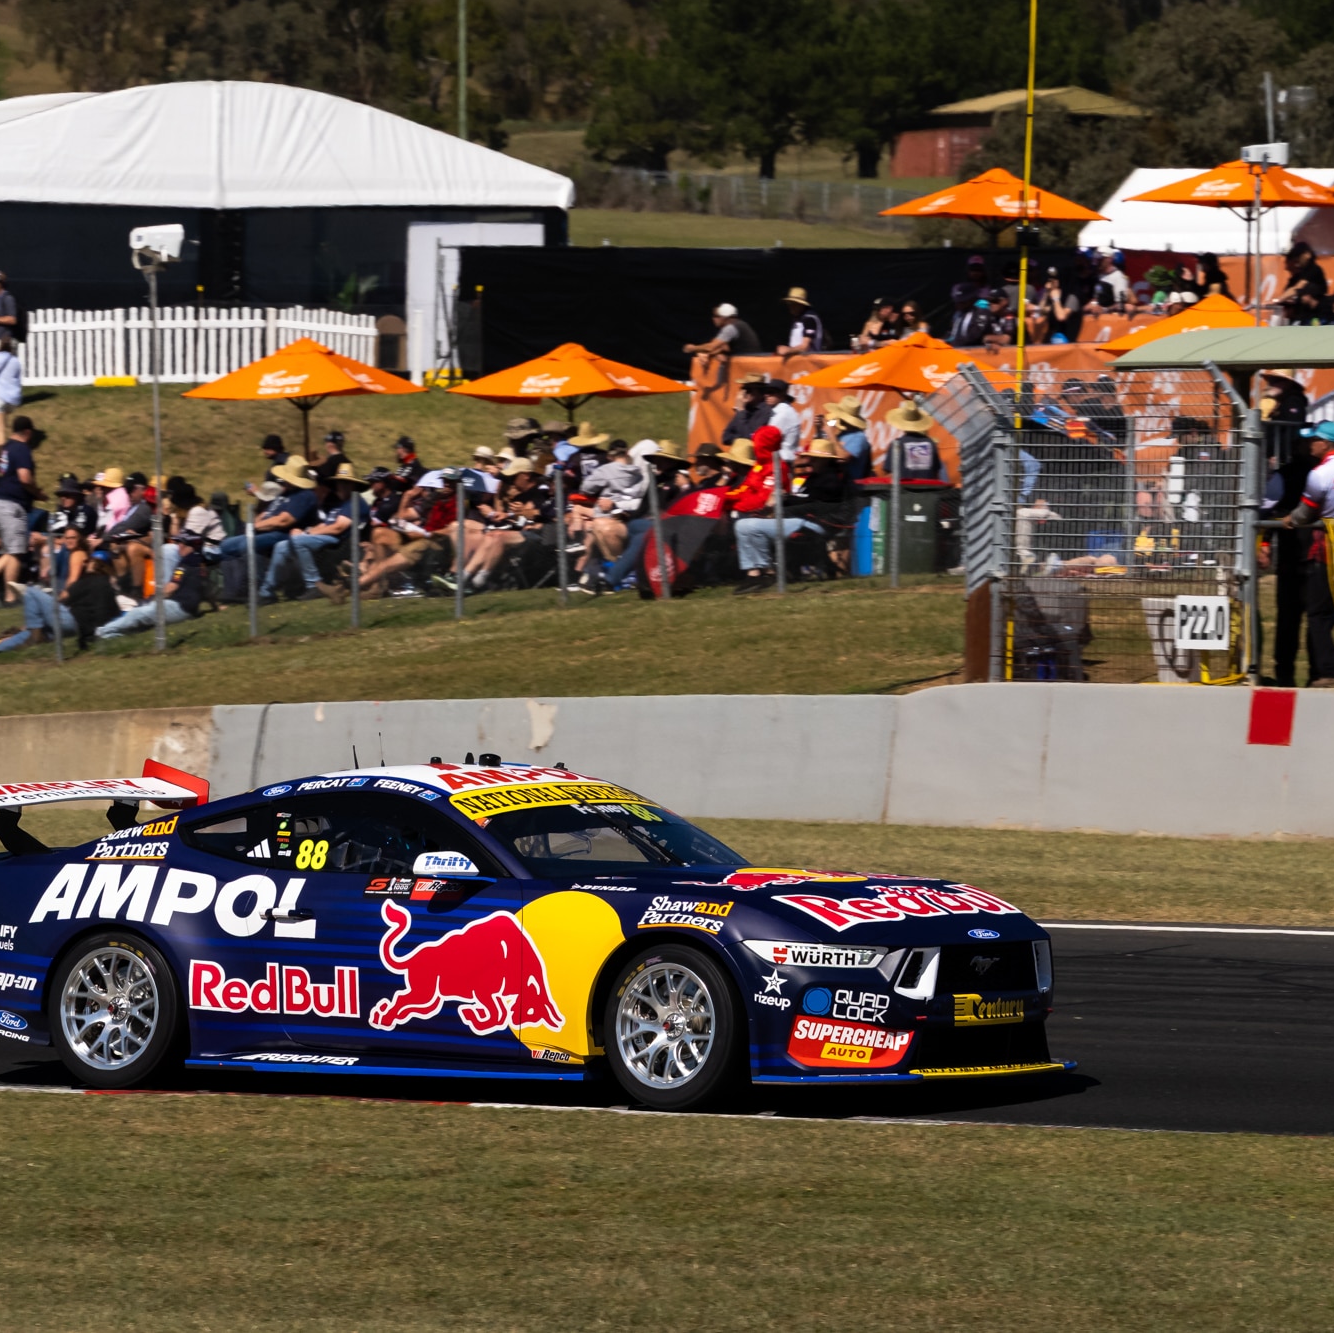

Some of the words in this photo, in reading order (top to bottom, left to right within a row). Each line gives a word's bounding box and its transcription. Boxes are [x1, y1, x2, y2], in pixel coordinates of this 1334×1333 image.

[1178, 604, 1225, 641] P22.0
[2, 779, 143, 794] AMPLIFY
[297, 778, 351, 792] PERCAT
[373, 778, 426, 795] FEENEY
[454, 785, 565, 815] NATIONAL
[91, 840, 169, 858] Partners
[295, 839, 329, 870] 88
[425, 855, 473, 871] Thrifty
[580, 884, 637, 892] DUNLOP
[28, 863, 319, 940] AMPOL
[638, 911, 725, 933] Partners
[791, 950, 856, 966] WÜRTH
[188, 959, 279, 1015] Red
[282, 963, 361, 1018] Bull
[754, 991, 792, 1011] rizeup
[834, 989, 890, 1010] QUAD
[832, 1003, 888, 1024] LOCK
[952, 993, 1025, 1027] Century
[794, 1019, 909, 1052] SUPERCHEAP
[253, 1052, 360, 1066] FREIGHTER
[542, 1049, 571, 1063] Repco
[827, 1047, 867, 1059] AUTO
